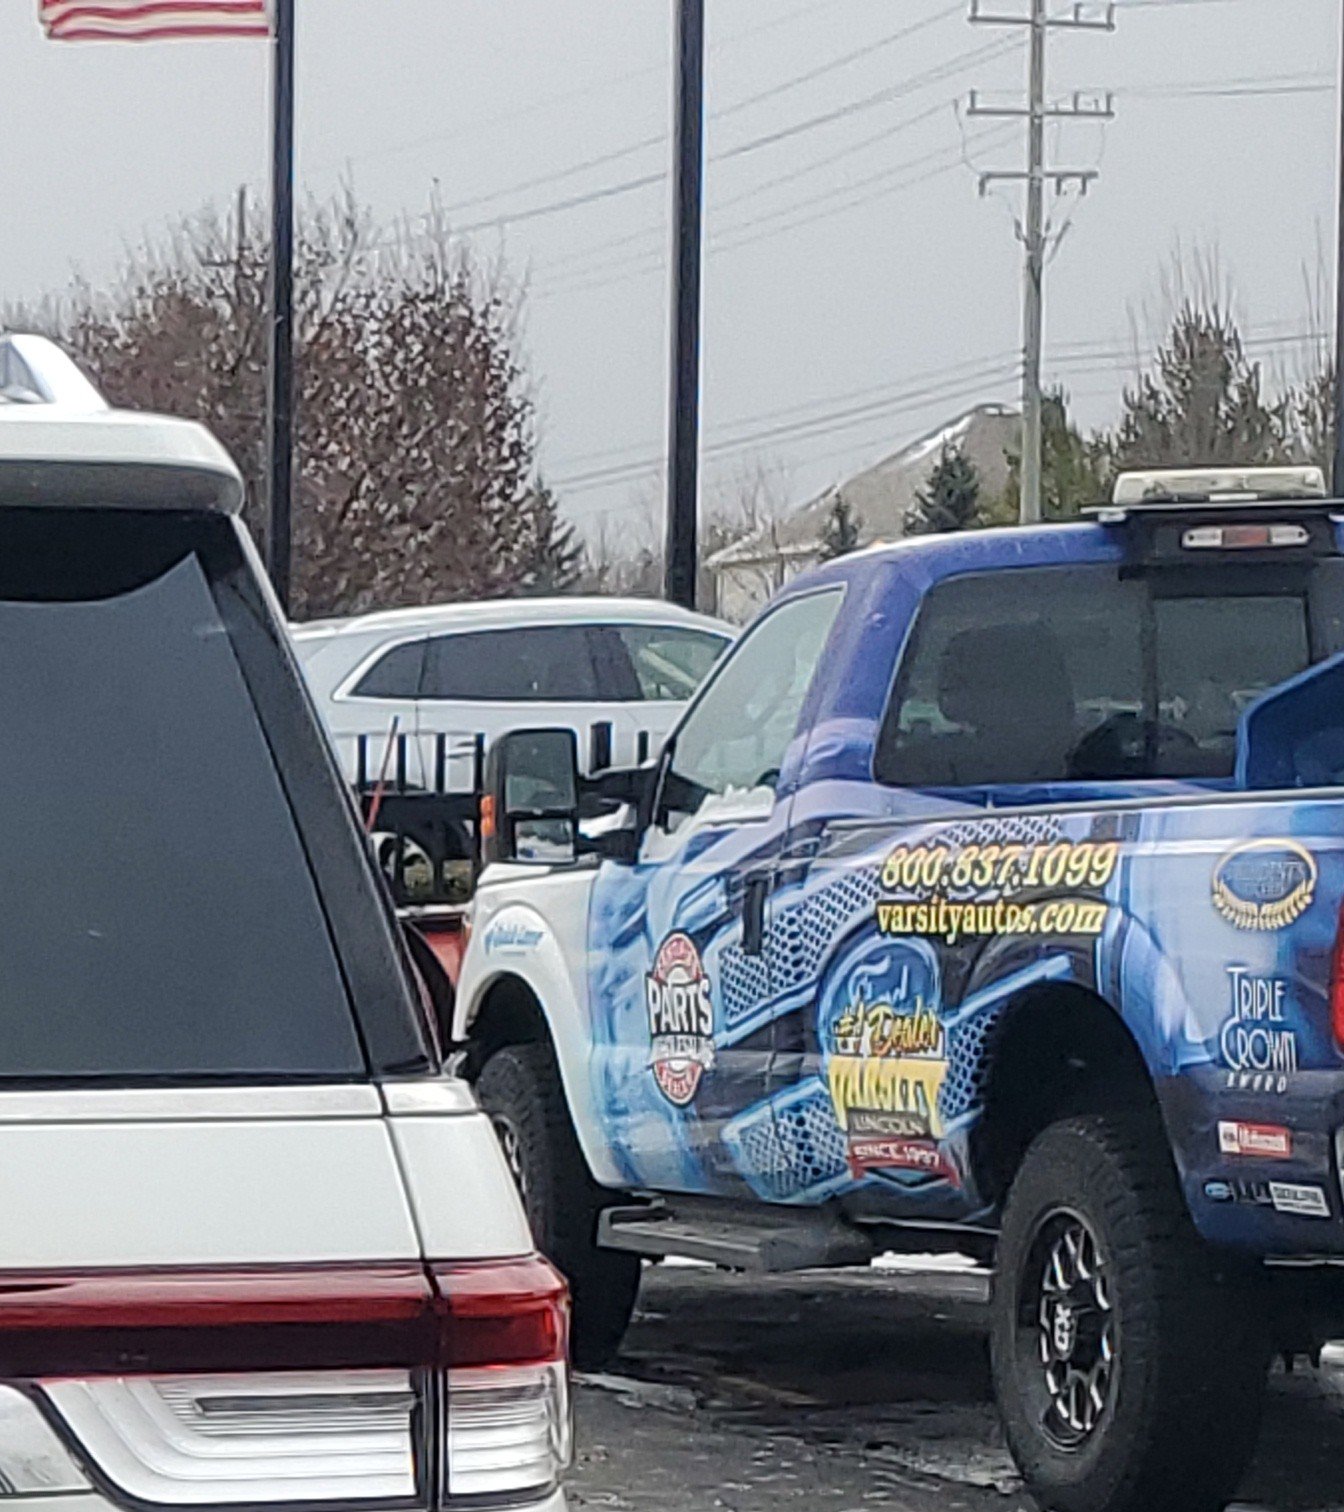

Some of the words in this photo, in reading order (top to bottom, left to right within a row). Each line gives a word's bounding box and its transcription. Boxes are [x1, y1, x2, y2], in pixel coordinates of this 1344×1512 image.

[882, 842, 1119, 887] 800.837.1099
[877, 896, 1107, 945] varsityautos.com
[647, 978, 712, 1035] PARTS
[1225, 966, 1286, 1021] TRIPLE
[866, 996, 940, 1056] Dealer
[1221, 1017, 1297, 1074] CROWN
[827, 1056, 949, 1140] VARSITY
[853, 1115, 926, 1136] LINCOLN
